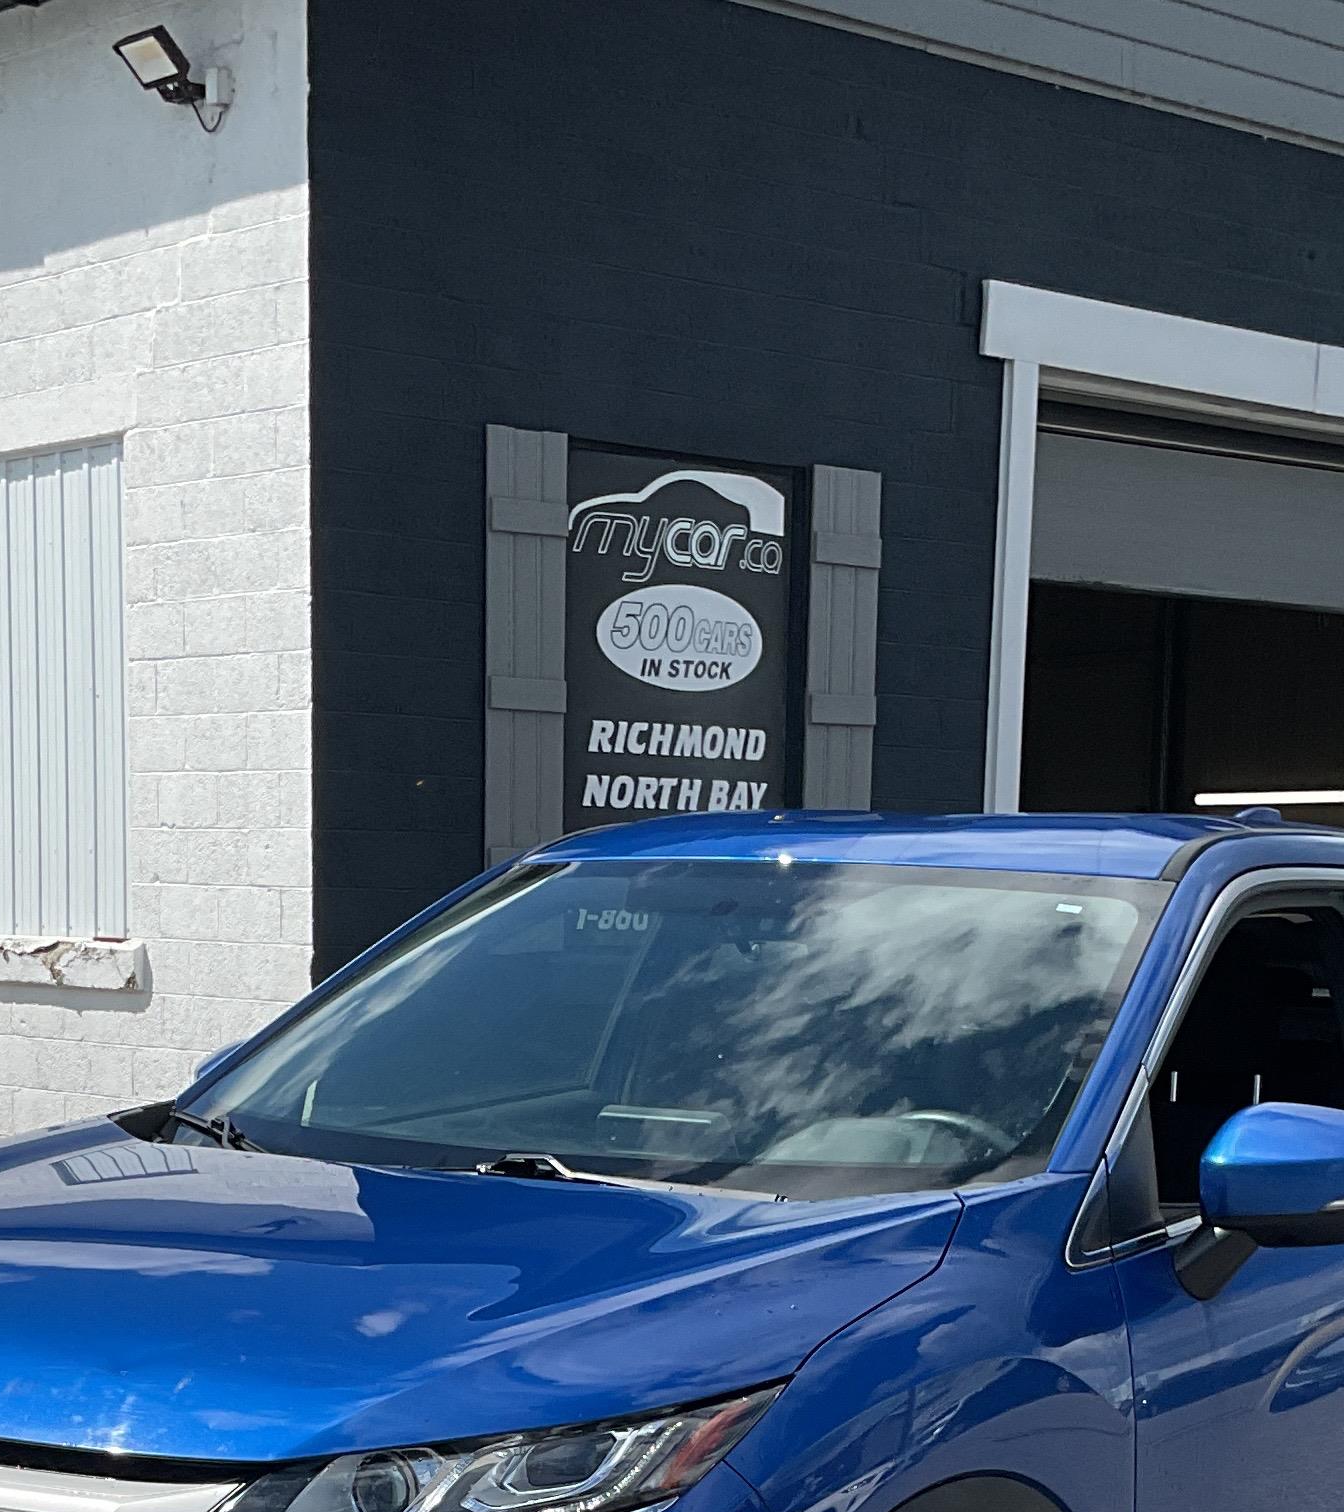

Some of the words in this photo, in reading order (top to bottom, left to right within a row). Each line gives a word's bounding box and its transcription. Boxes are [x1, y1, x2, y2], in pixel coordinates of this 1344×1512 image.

[572, 511, 783, 582] mycar.ca
[640, 658, 662, 678] IN
[667, 659, 733, 680] STOCK
[587, 719, 767, 761] RICHMOND
[582, 774, 703, 811] NORTH
[708, 779, 768, 812] BAY
